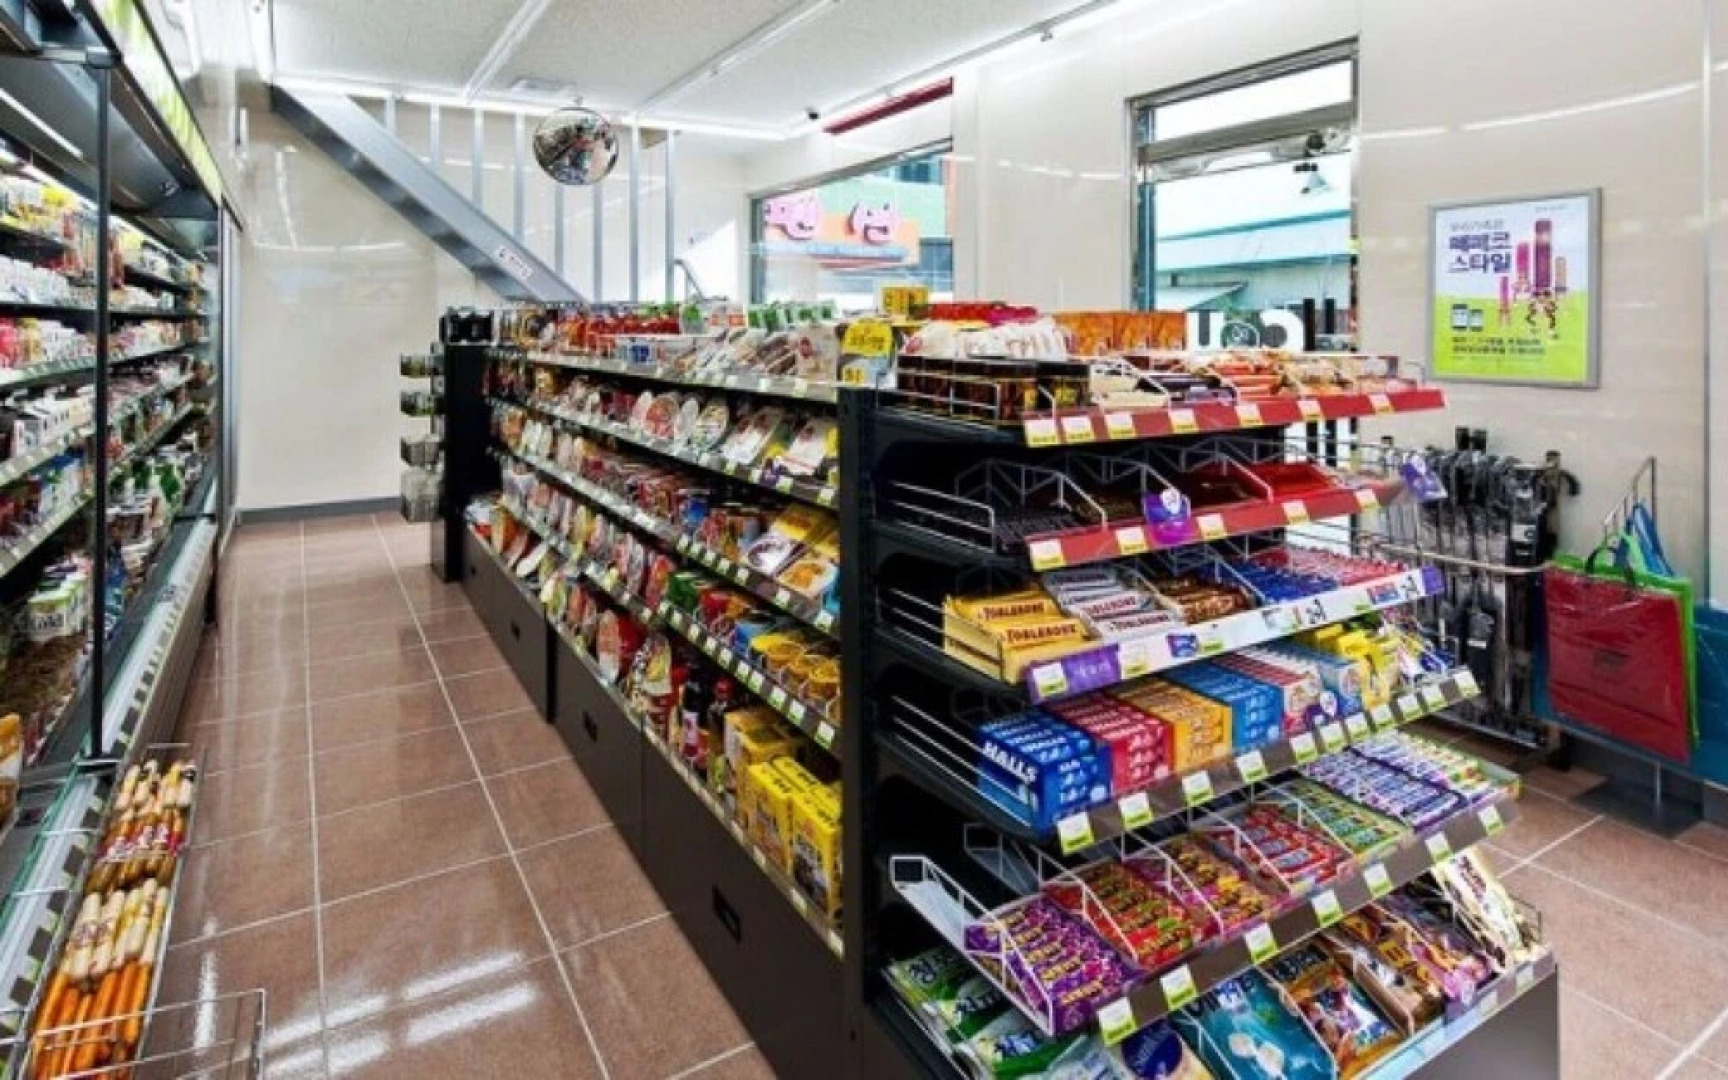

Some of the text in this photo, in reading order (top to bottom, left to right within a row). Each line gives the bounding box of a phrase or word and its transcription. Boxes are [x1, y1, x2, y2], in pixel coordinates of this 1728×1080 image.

[1449, 252, 1511, 274] 스타일
[1007, 624, 1076, 643] TOBLERONE
[983, 741, 1038, 782] HALLS
